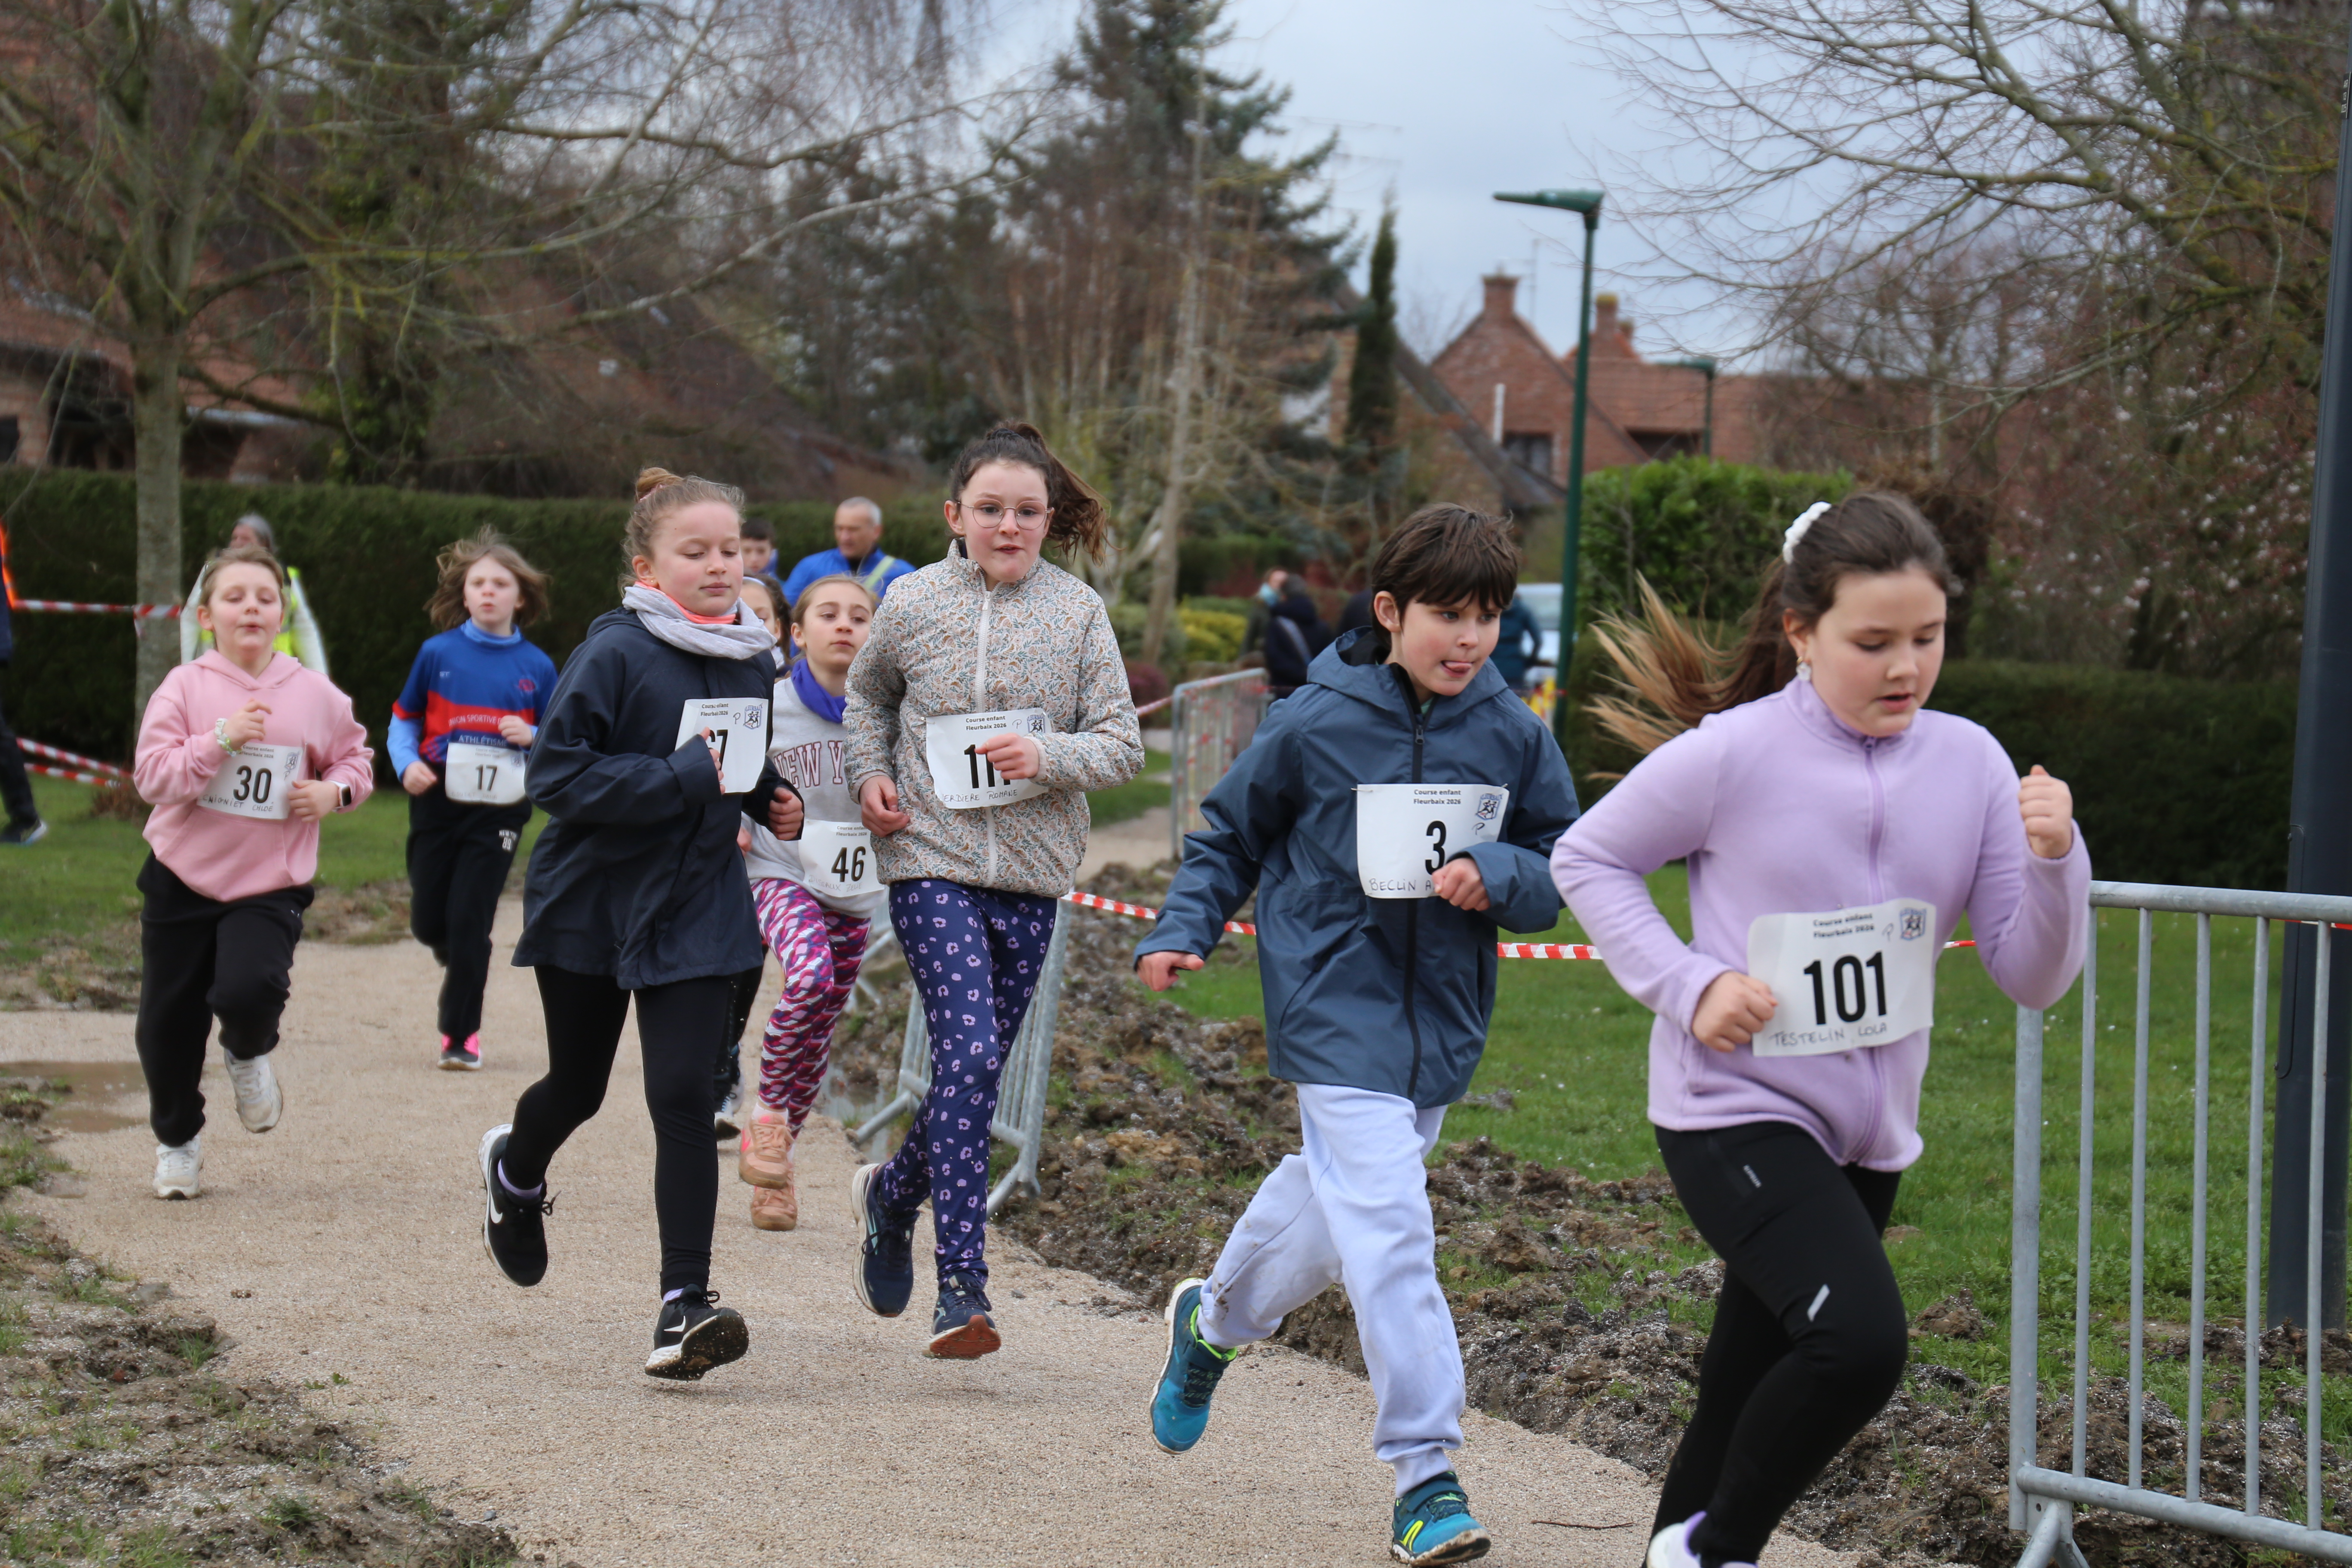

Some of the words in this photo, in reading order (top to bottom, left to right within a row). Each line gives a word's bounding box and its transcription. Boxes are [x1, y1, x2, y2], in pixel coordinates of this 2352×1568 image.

[467, 714, 496, 724] SPORTIVE
[233, 765, 272, 803] 30
[475, 763, 497, 791] 17
[964, 744, 1011, 788] 11
[831, 846, 866, 882] 46
[1425, 820, 1447, 876] 3
[1803, 950, 1887, 1026] 101
[1858, 1022, 1887, 1037] LOLA
